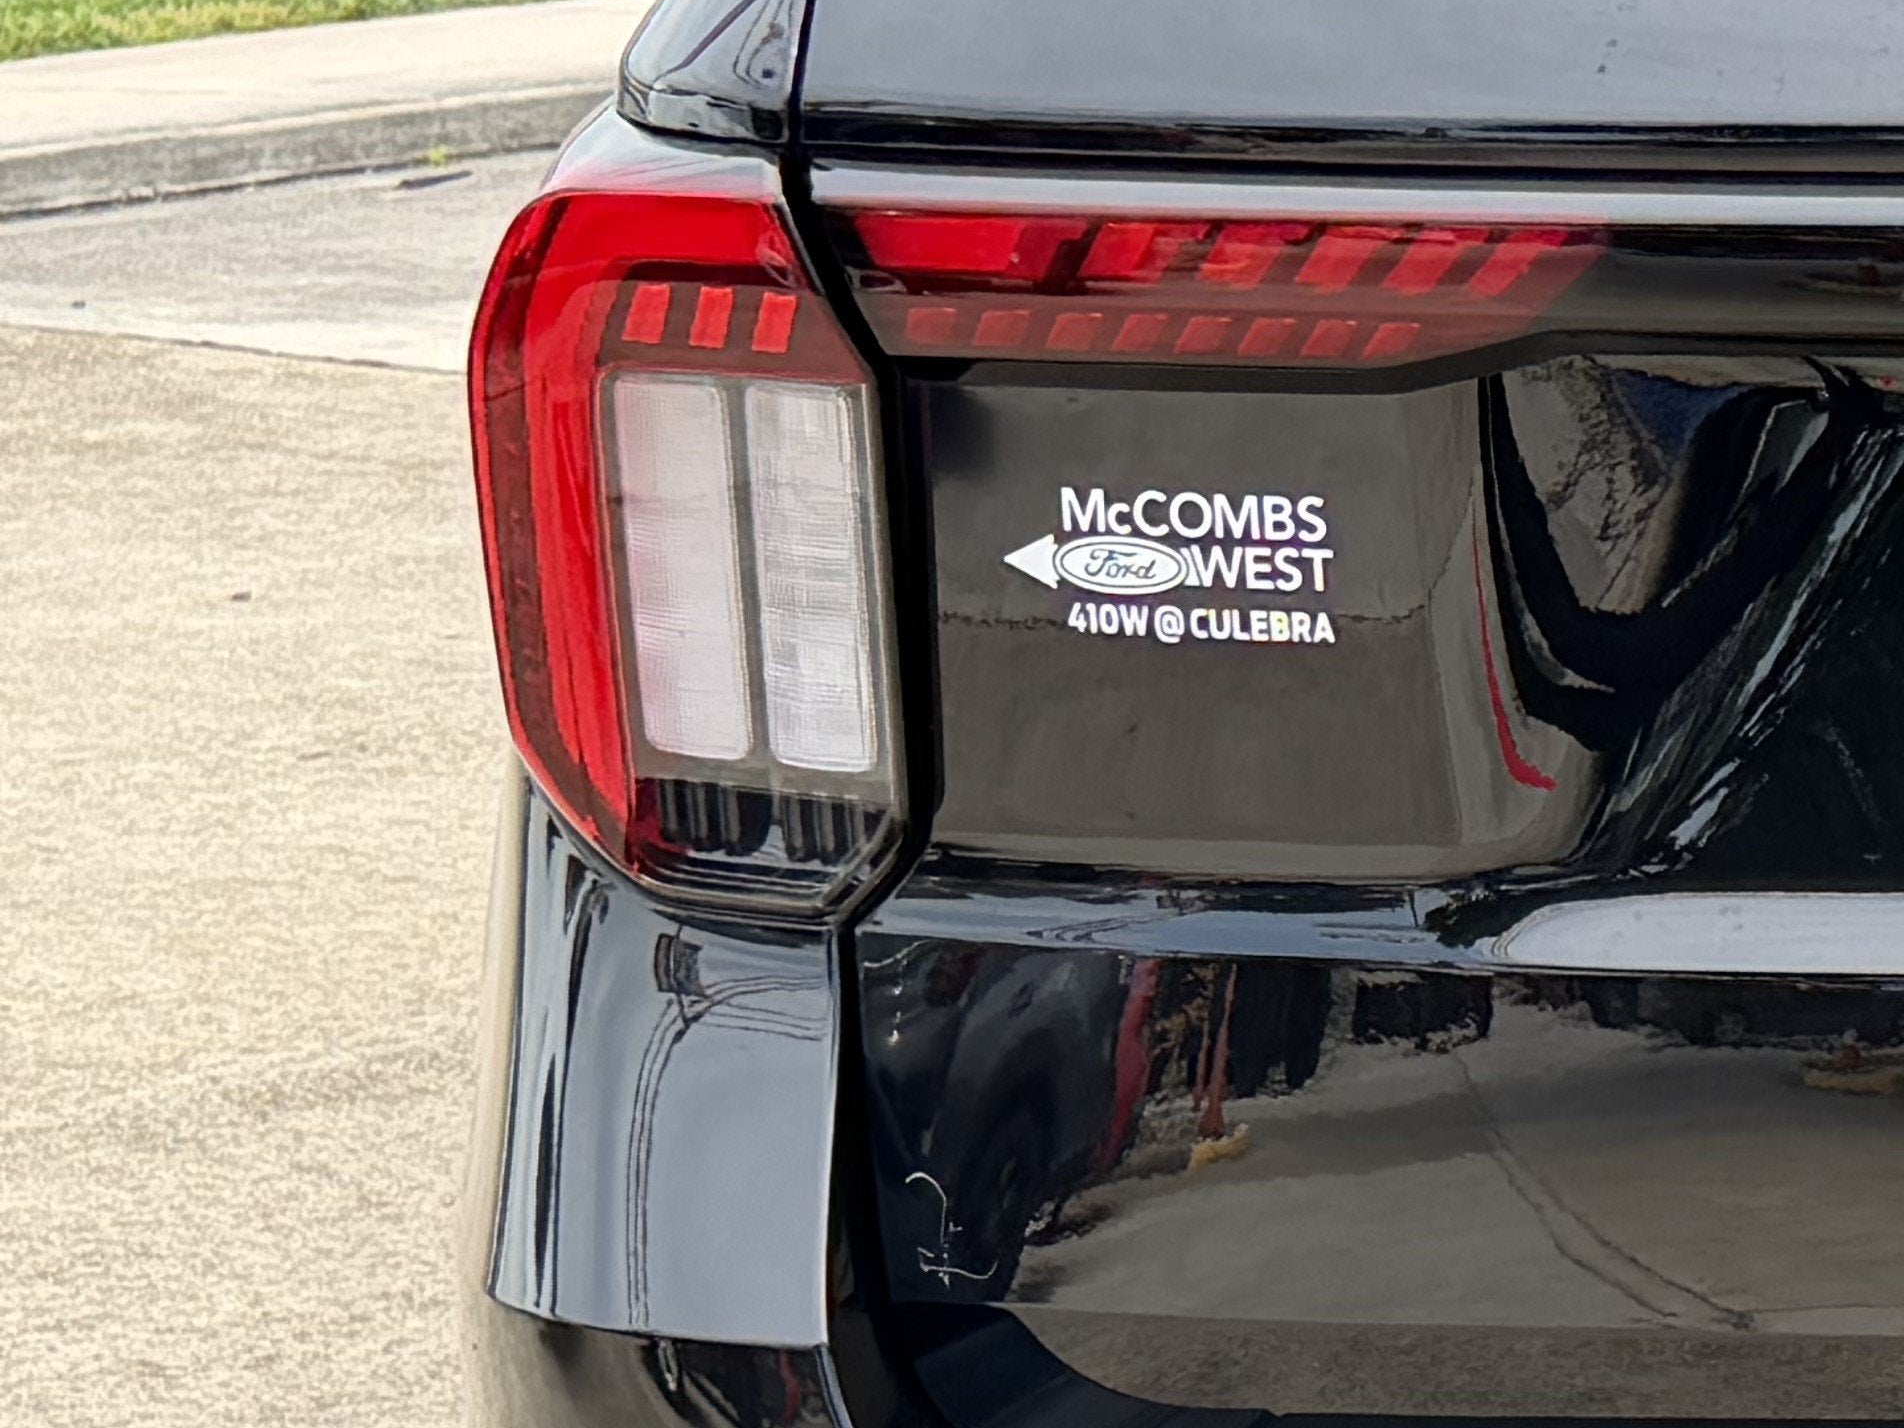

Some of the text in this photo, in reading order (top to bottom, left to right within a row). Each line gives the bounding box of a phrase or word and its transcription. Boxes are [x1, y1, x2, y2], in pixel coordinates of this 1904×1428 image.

[1060, 486, 1328, 543] McCOMBS
[1084, 544, 1335, 593] Ford WEST
